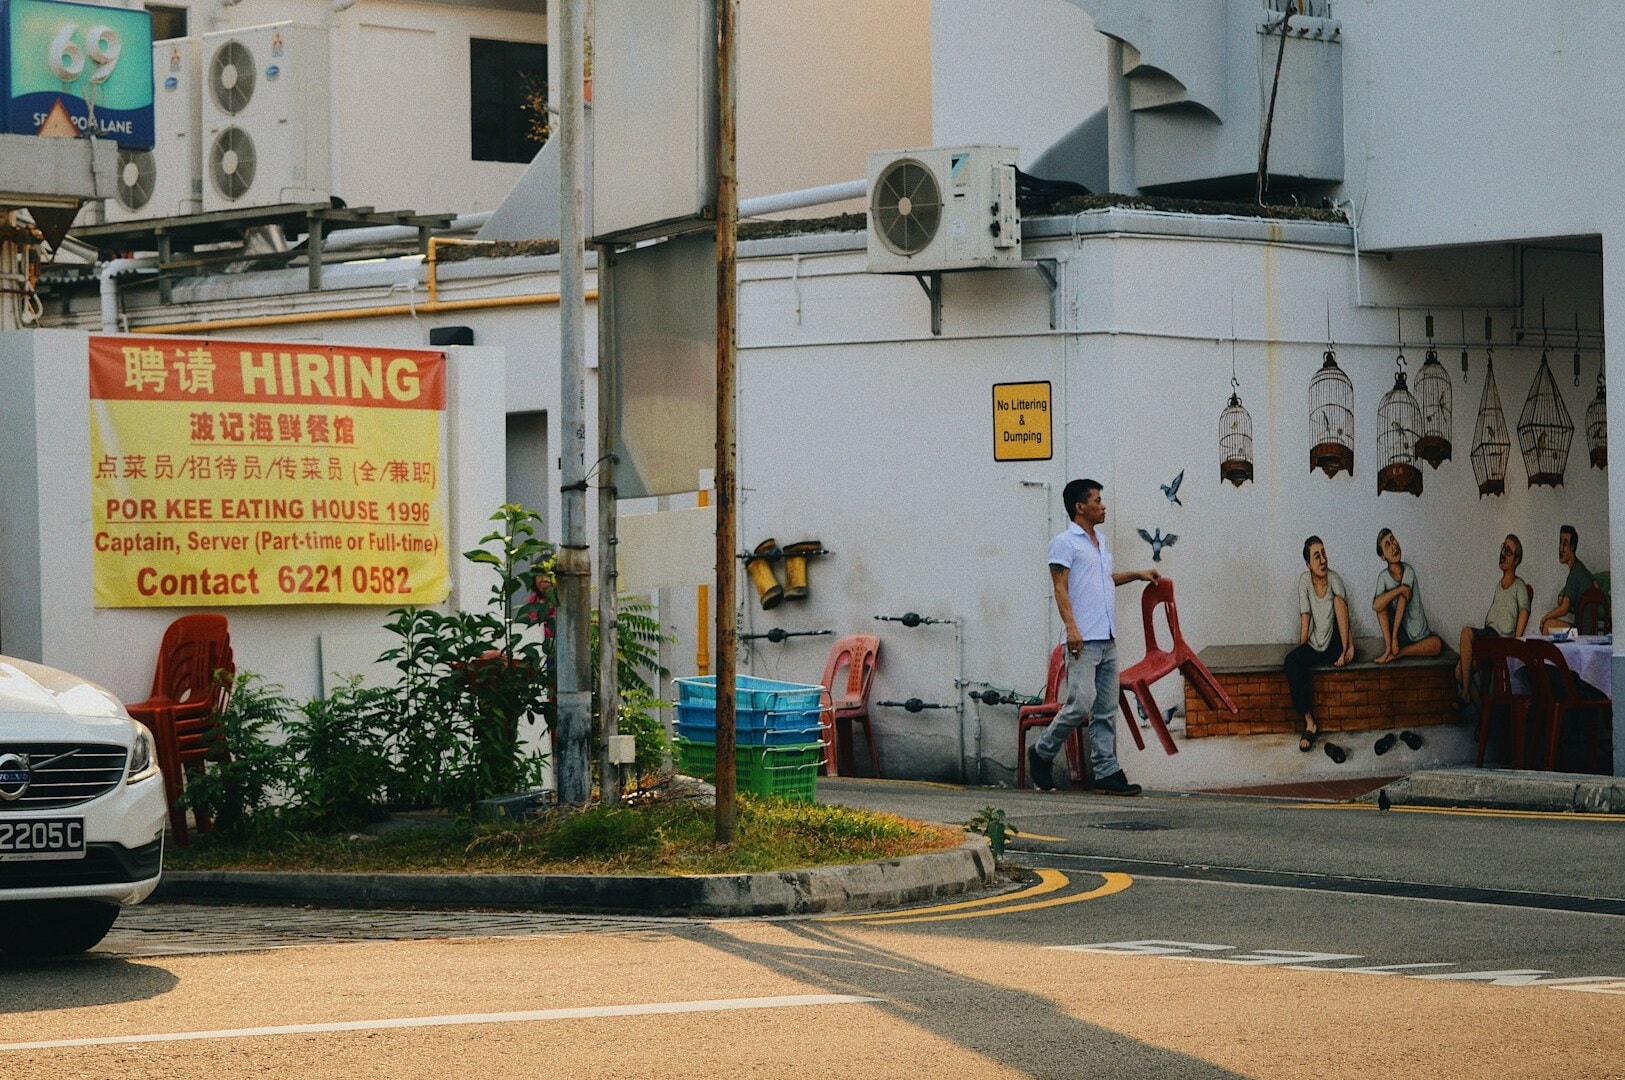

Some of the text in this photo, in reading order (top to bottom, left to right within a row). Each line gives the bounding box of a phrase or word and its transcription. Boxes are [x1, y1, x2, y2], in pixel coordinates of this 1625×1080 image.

[49, 21, 121, 83] 69
[101, 119, 133, 134] LANE
[122, 346, 421, 401] 聘请 HIRING
[997, 398, 1047, 412] No Littering
[189, 411, 355, 444] 波记海鲜餐馆
[1019, 414, 1025, 426] &
[1003, 430, 1042, 444] Dumping
[106, 499, 430, 522] POR KEE EATING HOUSE 1996
[95, 531, 438, 557] Captain, Server (Part-time or Full-time)
[137, 564, 412, 596] Contact 6221 0582
